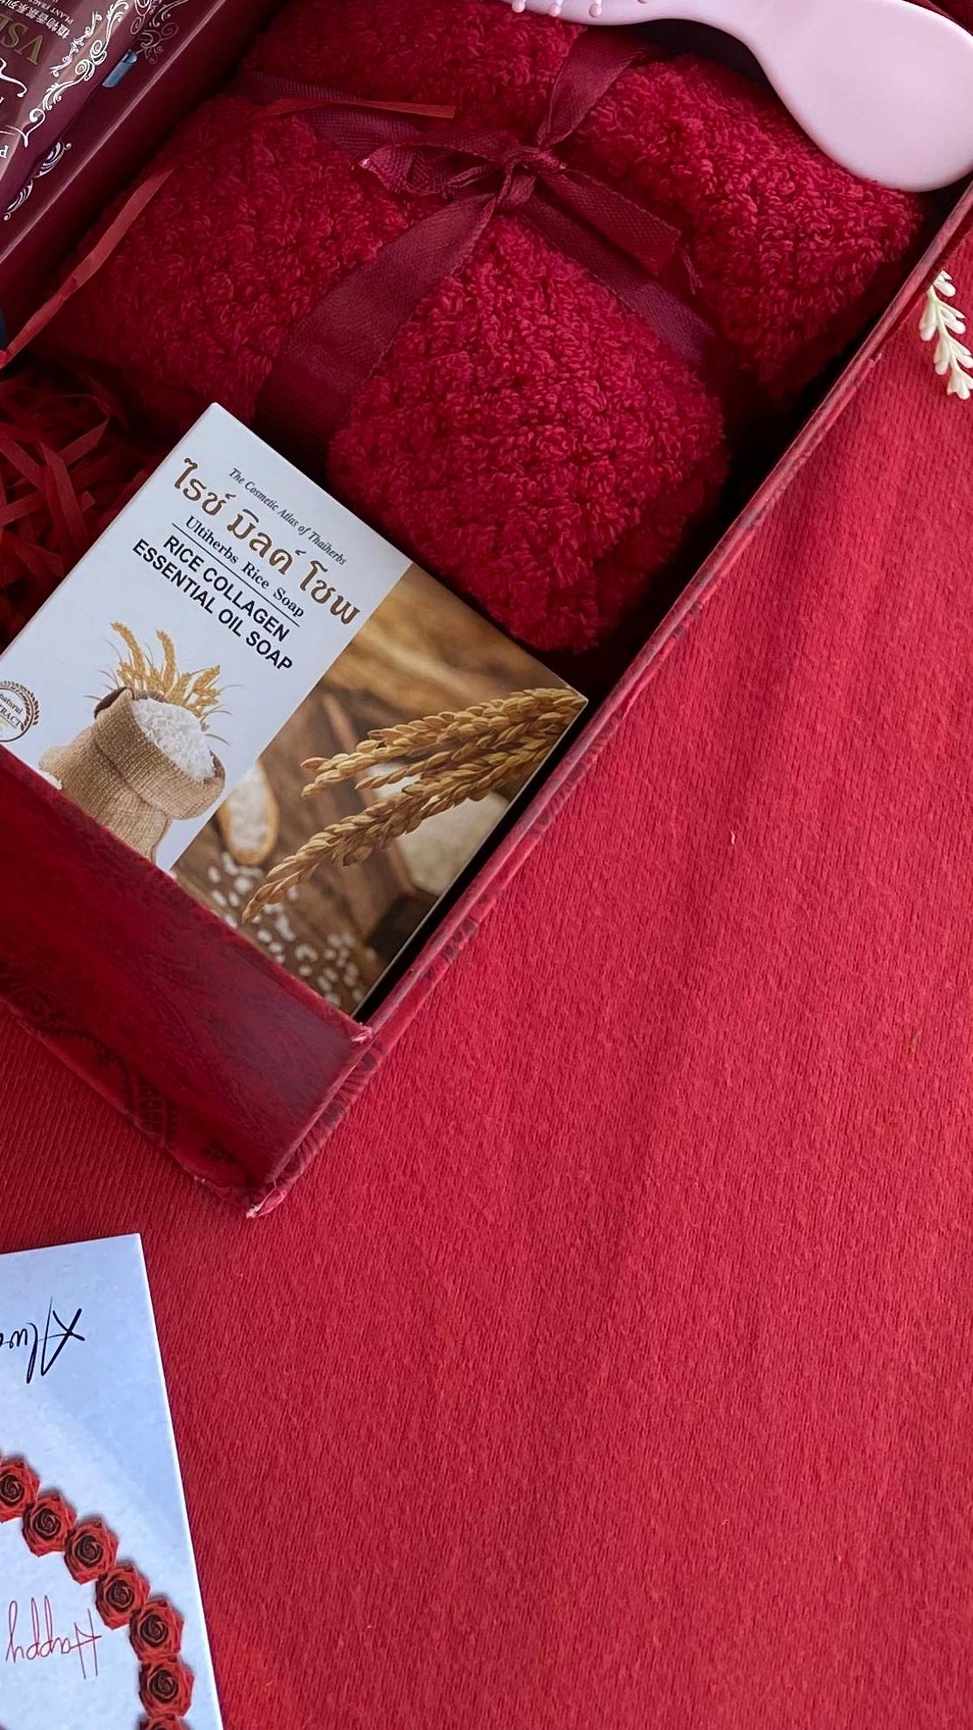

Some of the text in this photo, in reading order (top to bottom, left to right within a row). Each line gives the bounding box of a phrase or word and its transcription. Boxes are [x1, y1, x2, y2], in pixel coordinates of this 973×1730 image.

[52, 6, 74, 25] PLANT
[185, 515, 305, 619] Ultiherbs Rice Soap
[229, 467, 347, 566] The Cosmetic Atlas of Thaiherbs
[131, 537, 294, 672] ESSENTIAL OIL SOAP
[163, 534, 290, 643] RICE COLLAGEN
[5, 1595, 103, 1681] Happy
